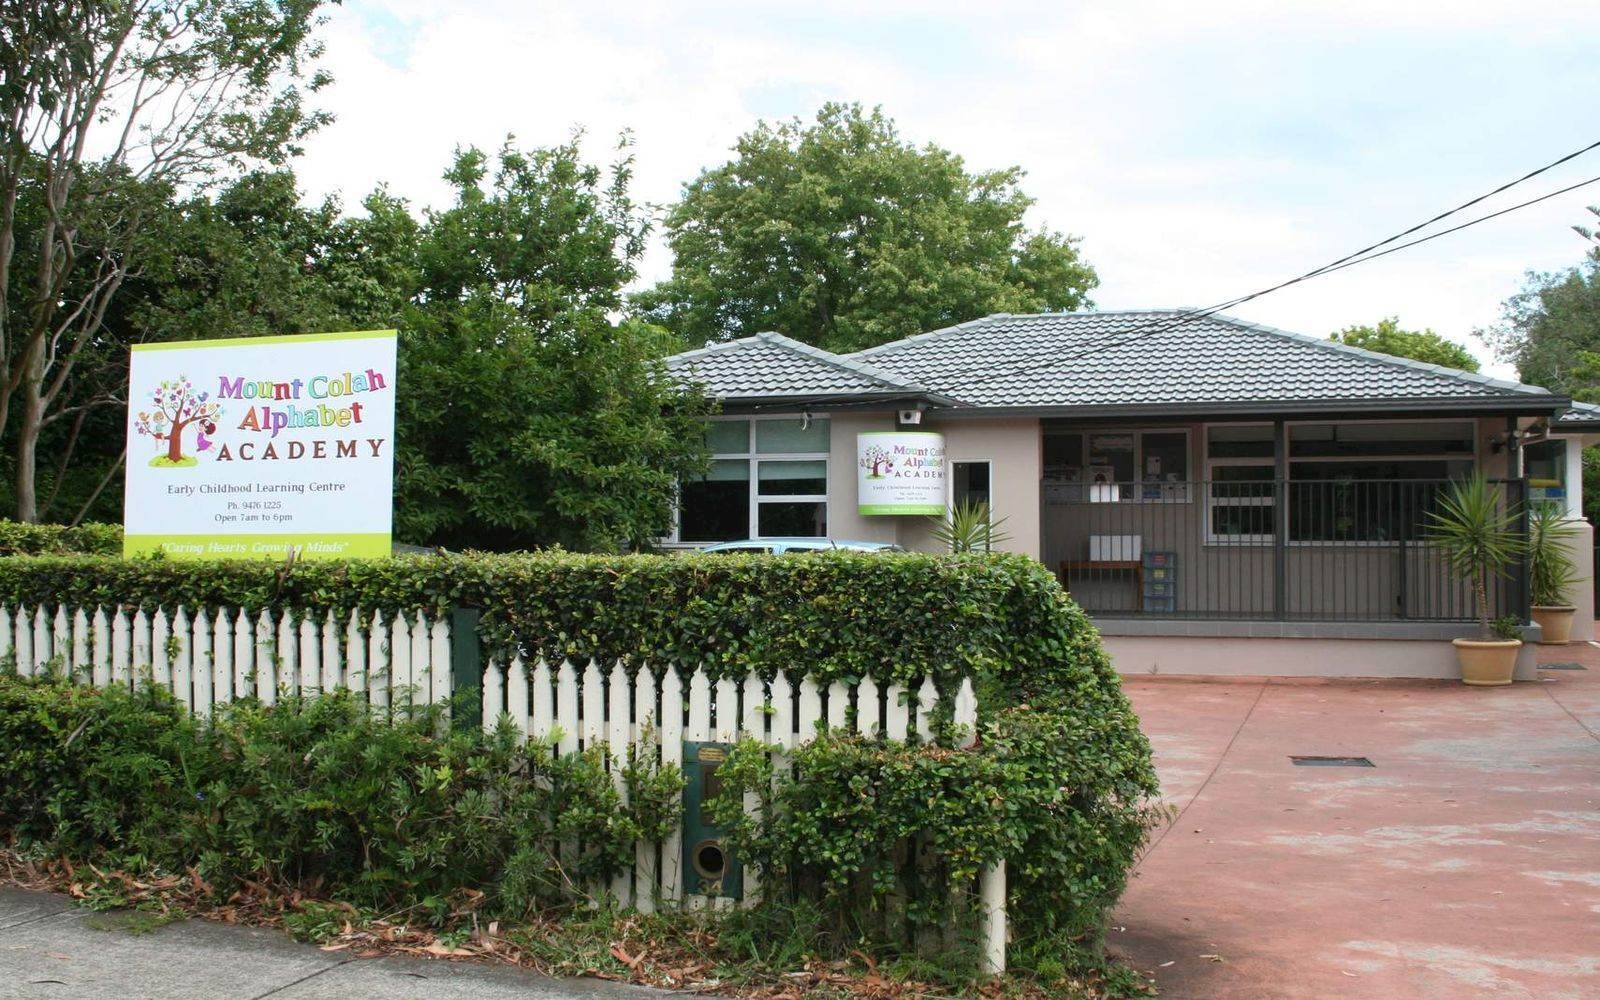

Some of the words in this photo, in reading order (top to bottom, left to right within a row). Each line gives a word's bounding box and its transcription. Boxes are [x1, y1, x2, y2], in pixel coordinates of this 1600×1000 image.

[217, 376, 304, 400] Mount
[308, 369, 387, 399] Colah
[237, 402, 363, 438] Alphabet
[216, 438, 385, 461] ACADEMY
[894, 470, 945, 478] ACADEM
[167, 484, 195, 496] Early
[199, 483, 252, 494] Childhood
[256, 481, 305, 494] Learning
[309, 482, 346, 492] Centre
[242, 501, 261, 510] 9476
[263, 501, 282, 510] 1225
[214, 514, 237, 524] Open
[240, 513, 258, 522] 7am
[262, 513, 271, 522] to
[273, 513, 293, 523] 6pm
[209, 542, 247, 553] Hearts
